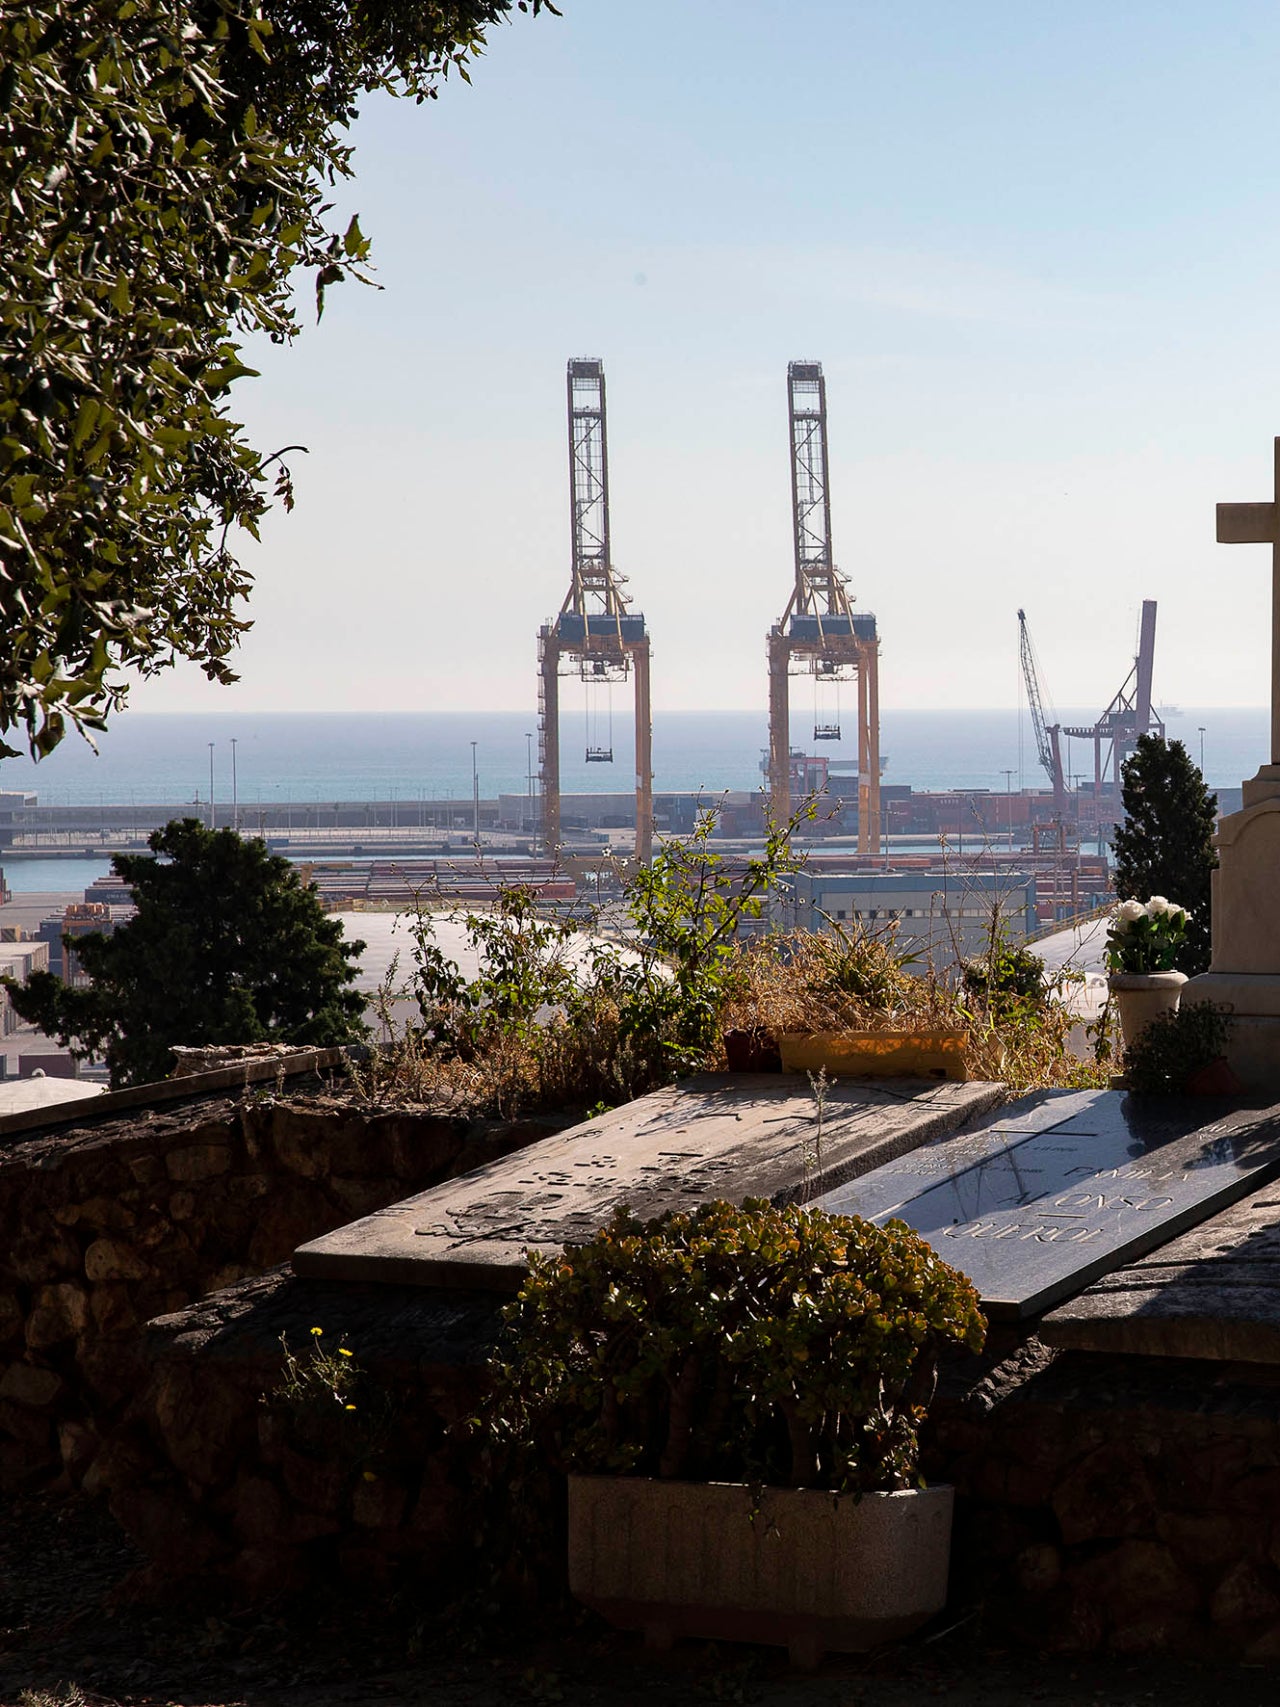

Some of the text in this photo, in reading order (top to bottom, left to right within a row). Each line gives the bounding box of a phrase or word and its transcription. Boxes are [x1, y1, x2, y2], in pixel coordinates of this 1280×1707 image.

[1064, 1166, 1189, 1182] FAMILIA
[997, 1191, 1173, 1212] ALONSO
[944, 1222, 1104, 1243] QUEROL
